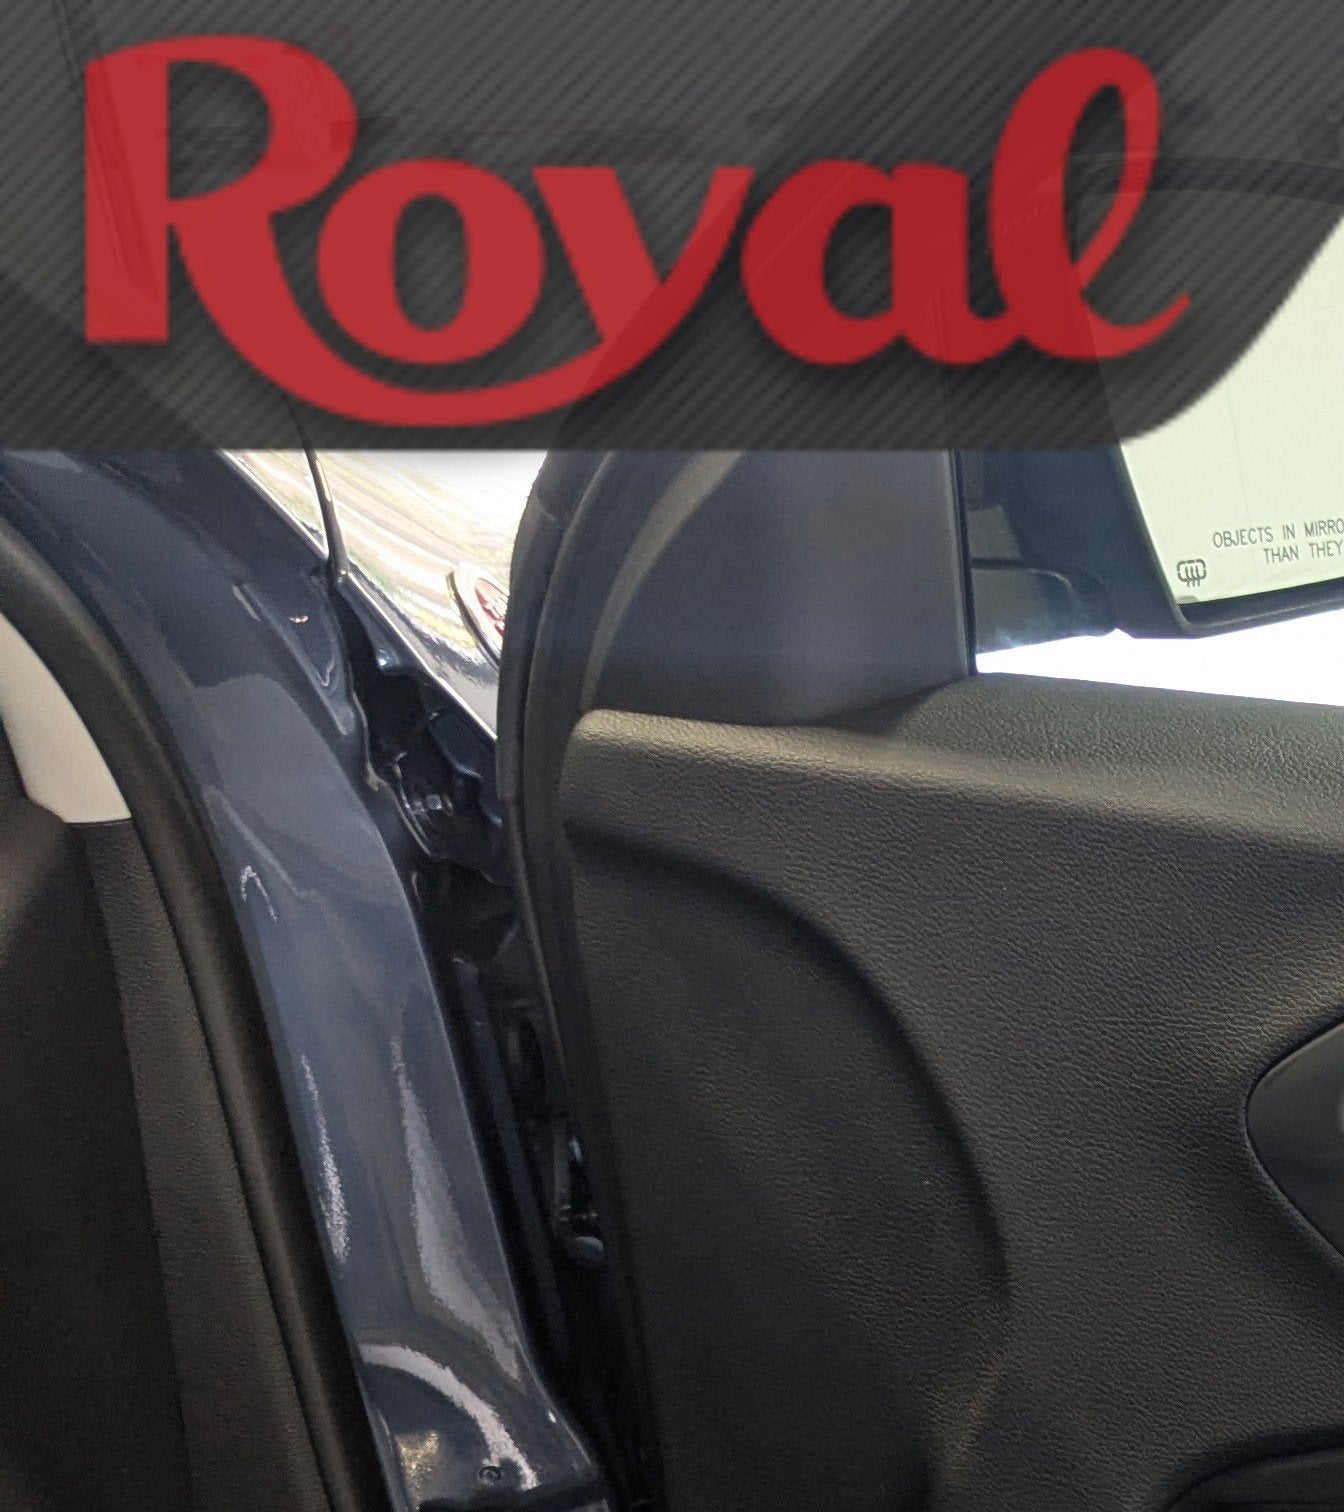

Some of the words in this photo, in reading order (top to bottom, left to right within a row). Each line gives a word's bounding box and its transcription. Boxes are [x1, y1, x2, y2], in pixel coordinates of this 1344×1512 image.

[1213, 527, 1273, 549] OBJECTS
[1282, 525, 1296, 541] IN
[1263, 545, 1299, 564] THAN
[1308, 541, 1343, 559] THEY
